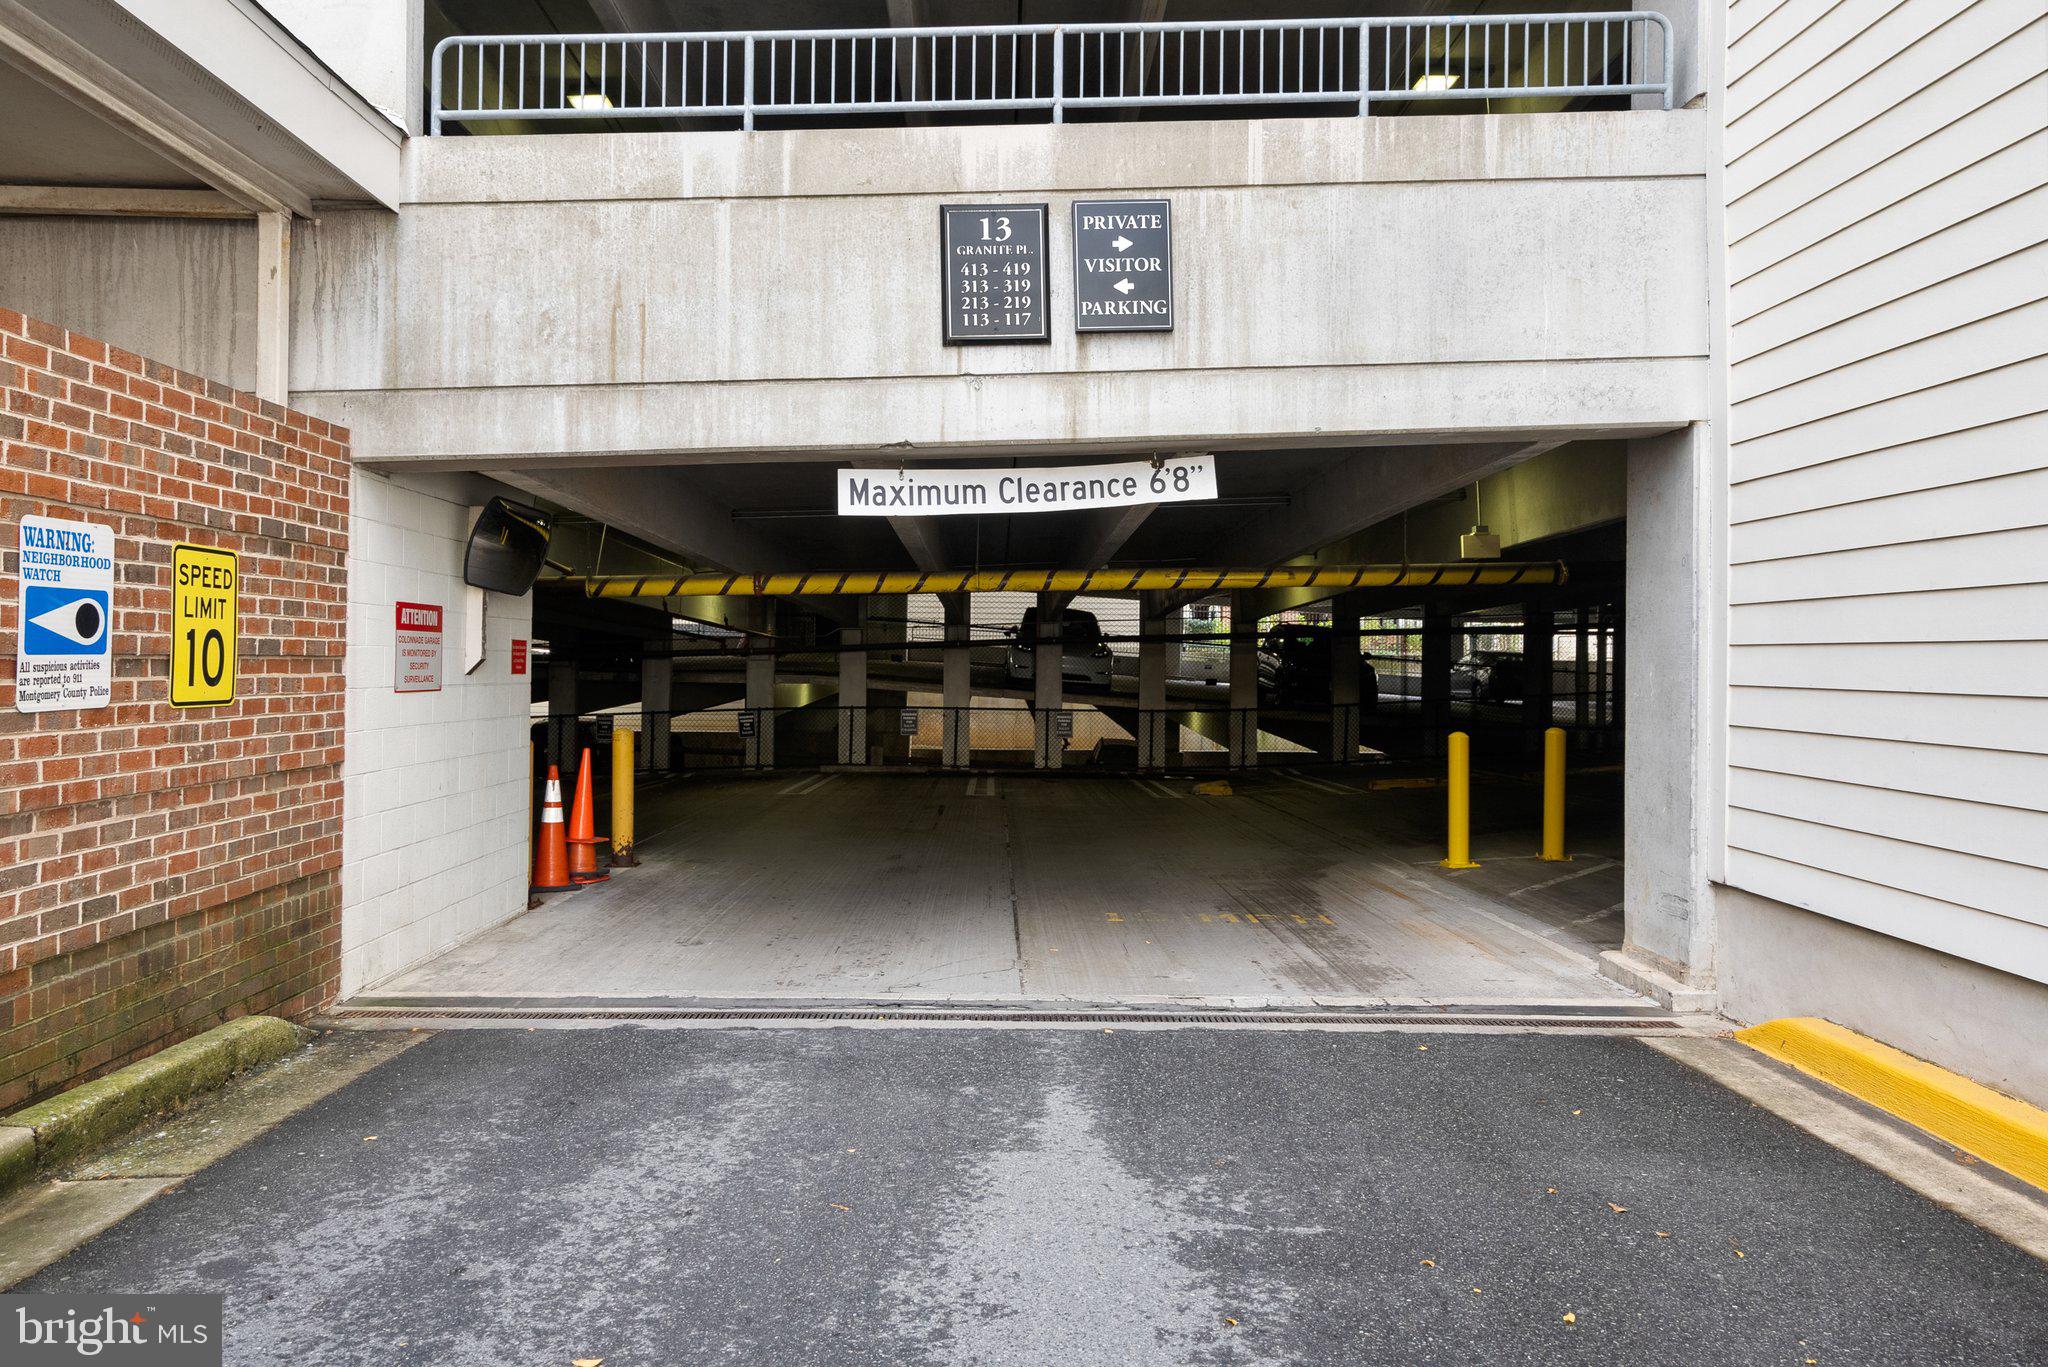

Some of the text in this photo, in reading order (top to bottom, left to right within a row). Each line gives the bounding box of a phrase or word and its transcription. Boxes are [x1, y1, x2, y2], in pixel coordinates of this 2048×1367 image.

[980, 217, 1012, 242] 13
[1082, 215, 1162, 230] PRIVATE
[956, 245, 1012, 255] GRANITE
[960, 263, 988, 276] 413
[1002, 262, 1031, 275] 419
[1084, 258, 1162, 272] VISITOR
[961, 280, 989, 293] 313
[1003, 280, 1031, 292] 319
[962, 297, 989, 310] 213
[1003, 296, 1031, 309] 219
[1081, 300, 1168, 316] PARKING
[963, 314, 989, 327] 113
[1005, 313, 1031, 326] 117
[849, 478, 987, 506] Maximum
[998, 475, 1138, 504] Clearance
[23, 526, 95, 554] WARNING:
[22, 550, 111, 570] NEIGHBORHOOD
[23, 567, 61, 582] WATCH
[179, 564, 232, 590] SPEED
[184, 596, 226, 620] LIMIT
[400, 608, 438, 626] ATTENTION
[186, 628, 225, 686] 10
[20, 661, 100, 674] All suspicious activities
[409, 662, 429, 670] SECURITY
[19, 674, 82, 688] are reported to 911
[19, 686, 109, 703] Montgomery County Police
